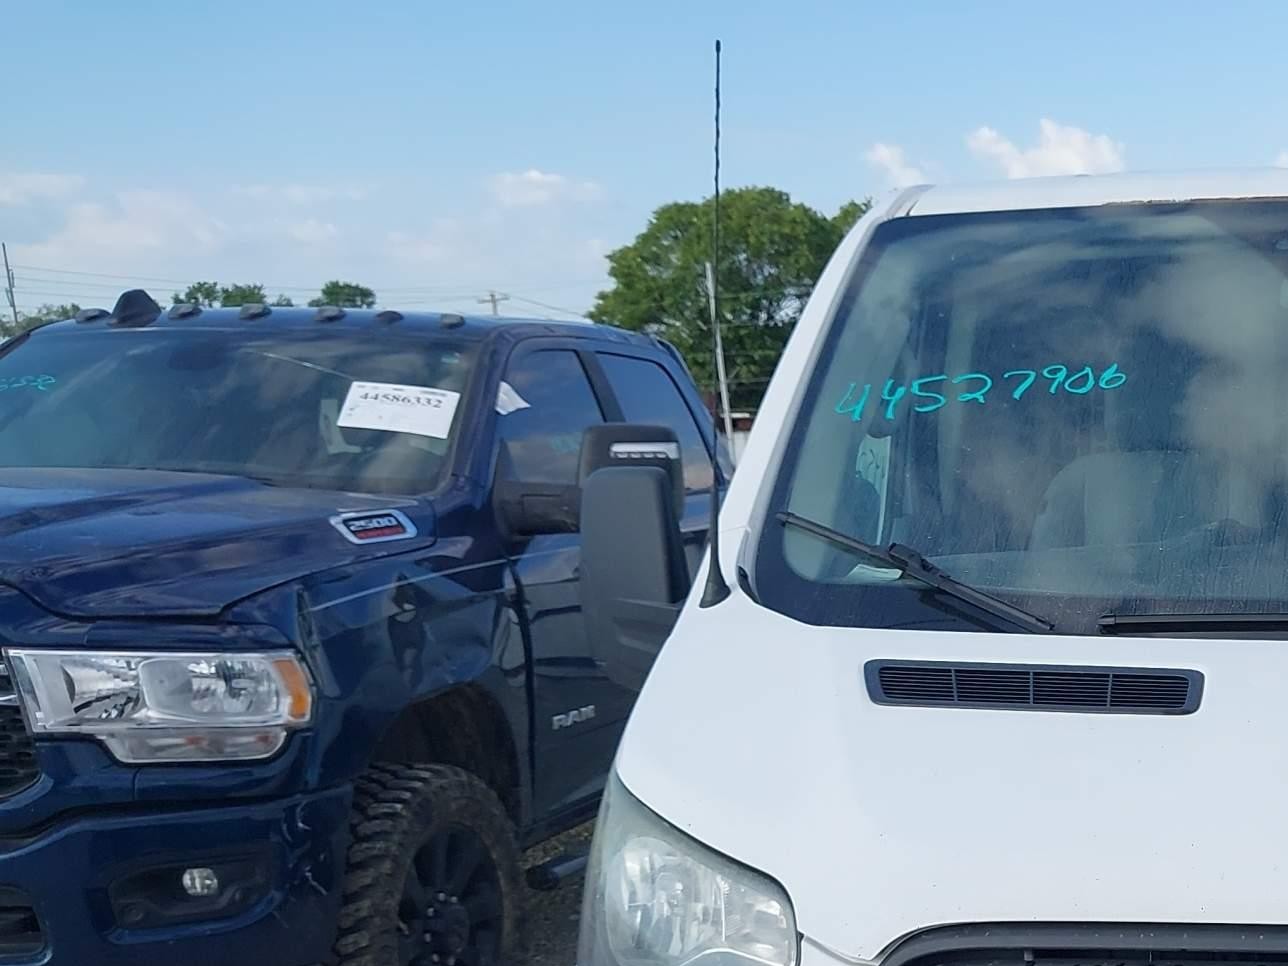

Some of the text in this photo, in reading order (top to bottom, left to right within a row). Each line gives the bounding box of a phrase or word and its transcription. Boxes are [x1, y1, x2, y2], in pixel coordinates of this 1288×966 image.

[359, 392, 443, 409] 44586332
[834, 363, 1128, 423] 44527906
[552, 704, 596, 730] RAM
